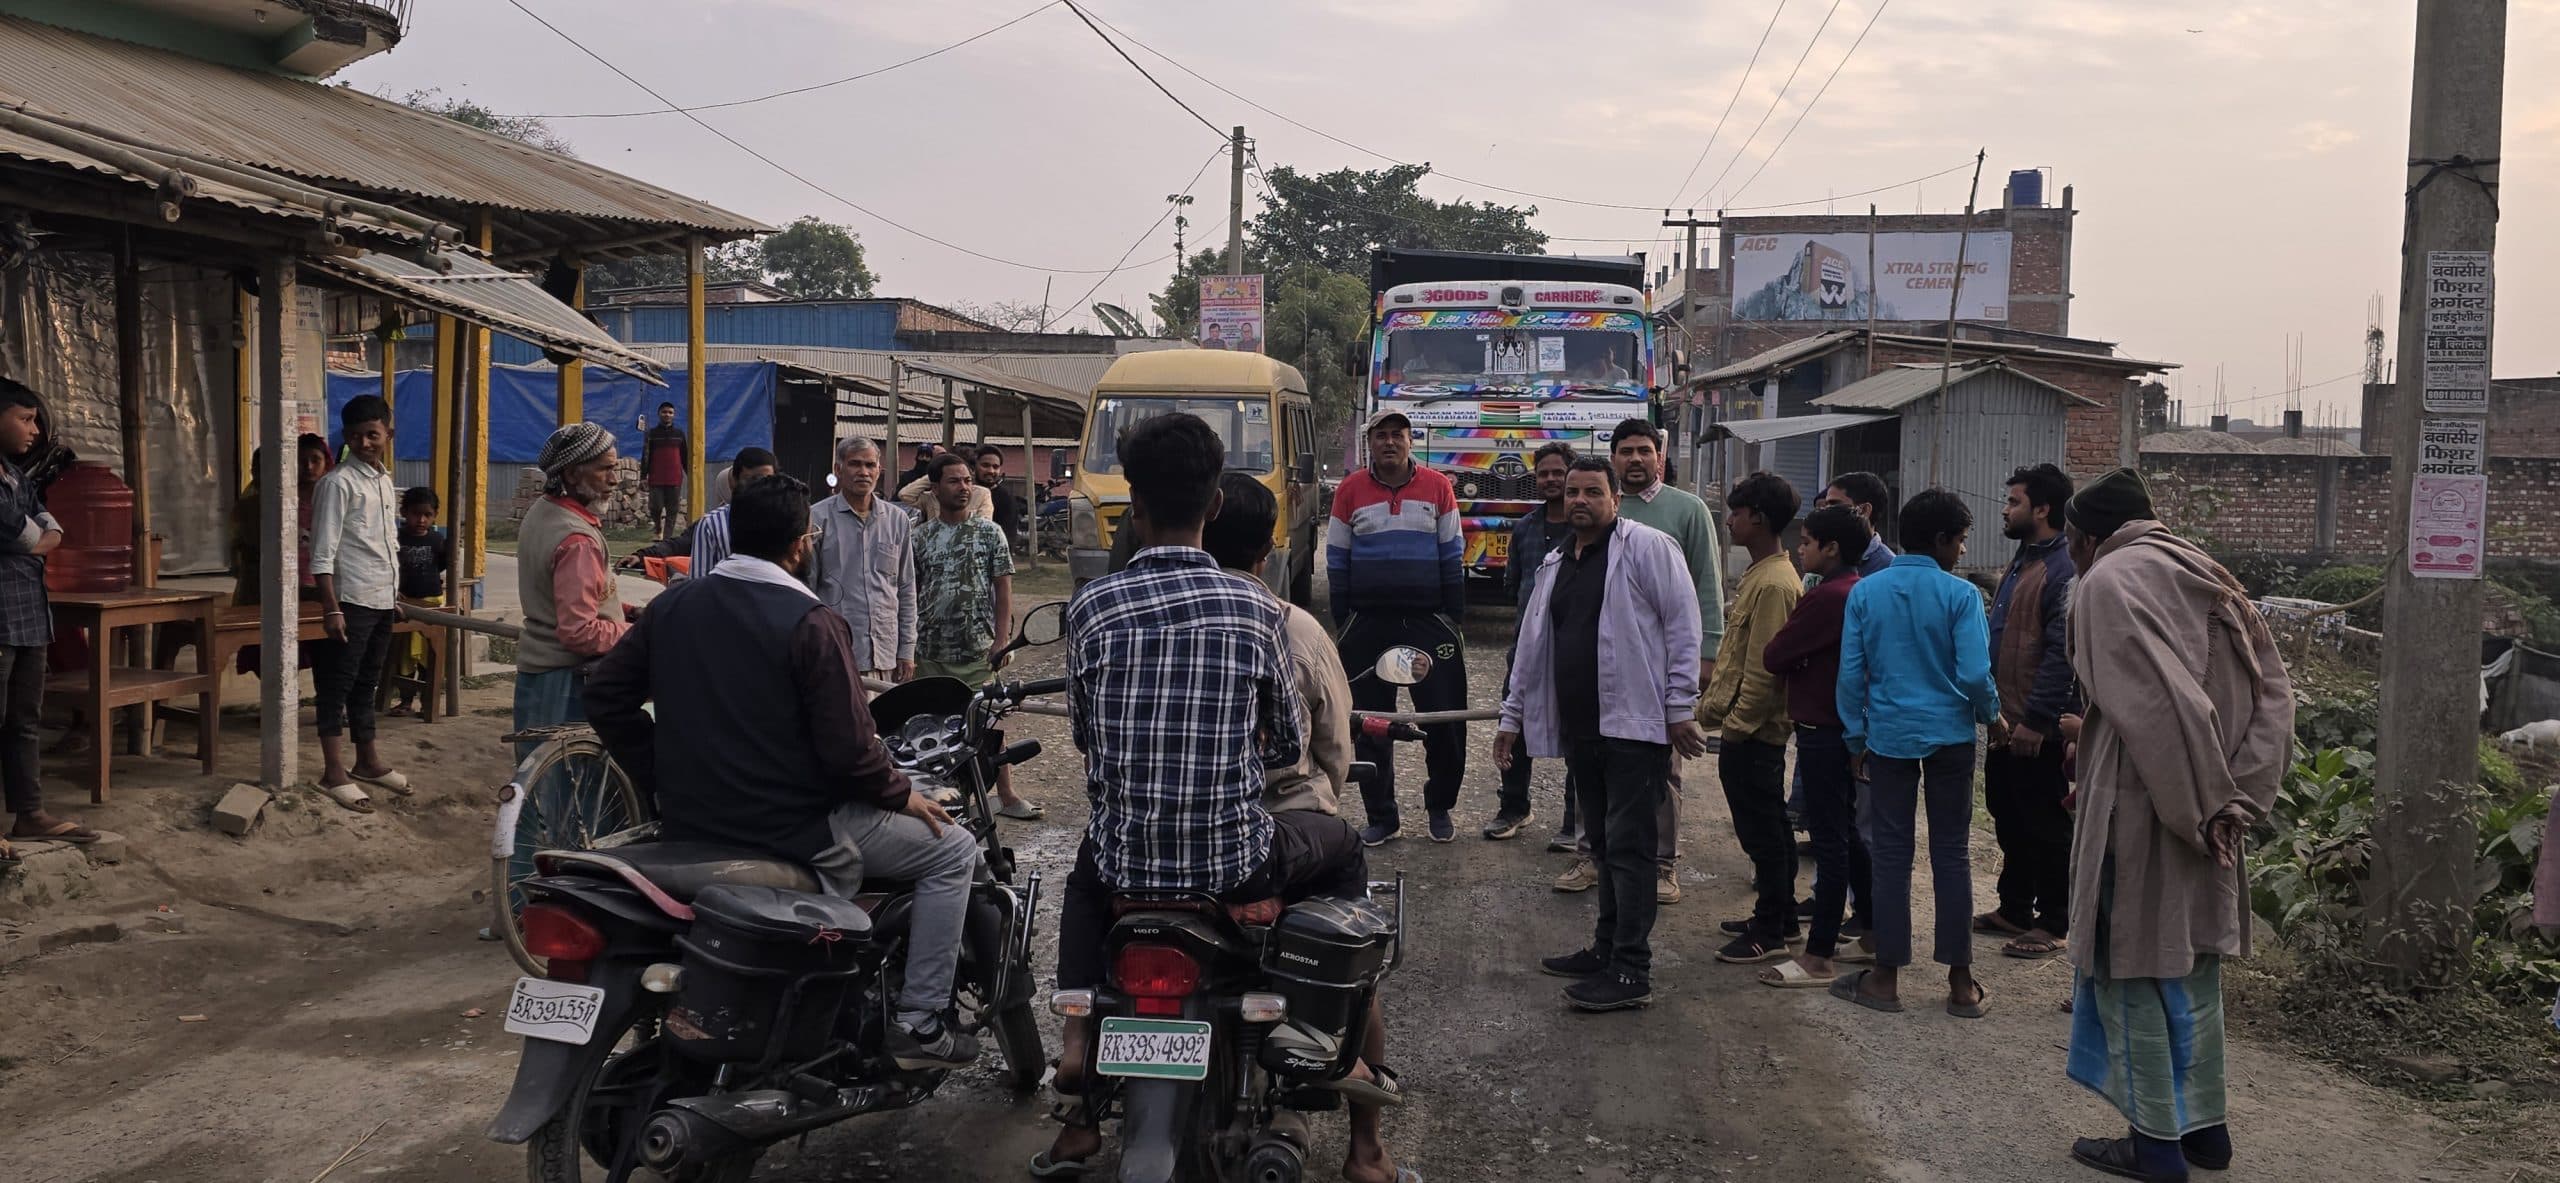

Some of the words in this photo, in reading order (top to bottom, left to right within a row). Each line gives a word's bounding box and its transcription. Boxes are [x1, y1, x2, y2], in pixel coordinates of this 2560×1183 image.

[1740, 238, 1777, 251] ACC
[1884, 262, 1923, 274] XTRA
[2432, 262, 2487, 277] बवासीर
[2433, 278, 2484, 293] फिशर
[1431, 290, 1488, 301] GOODS
[1535, 290, 1592, 302] CARRIER
[2431, 293, 2487, 308] भगंदर
[1463, 313, 1504, 324] India
[1481, 386, 1550, 398] 2024
[1493, 439, 1525, 448] TATA
[2424, 429, 2479, 444] बवासीर
[2425, 444, 2475, 460] फिशर
[2422, 460, 2478, 475] भगंदर
[1496, 535, 1507, 544] WB
[1280, 951, 1319, 967] AEROSTAR
